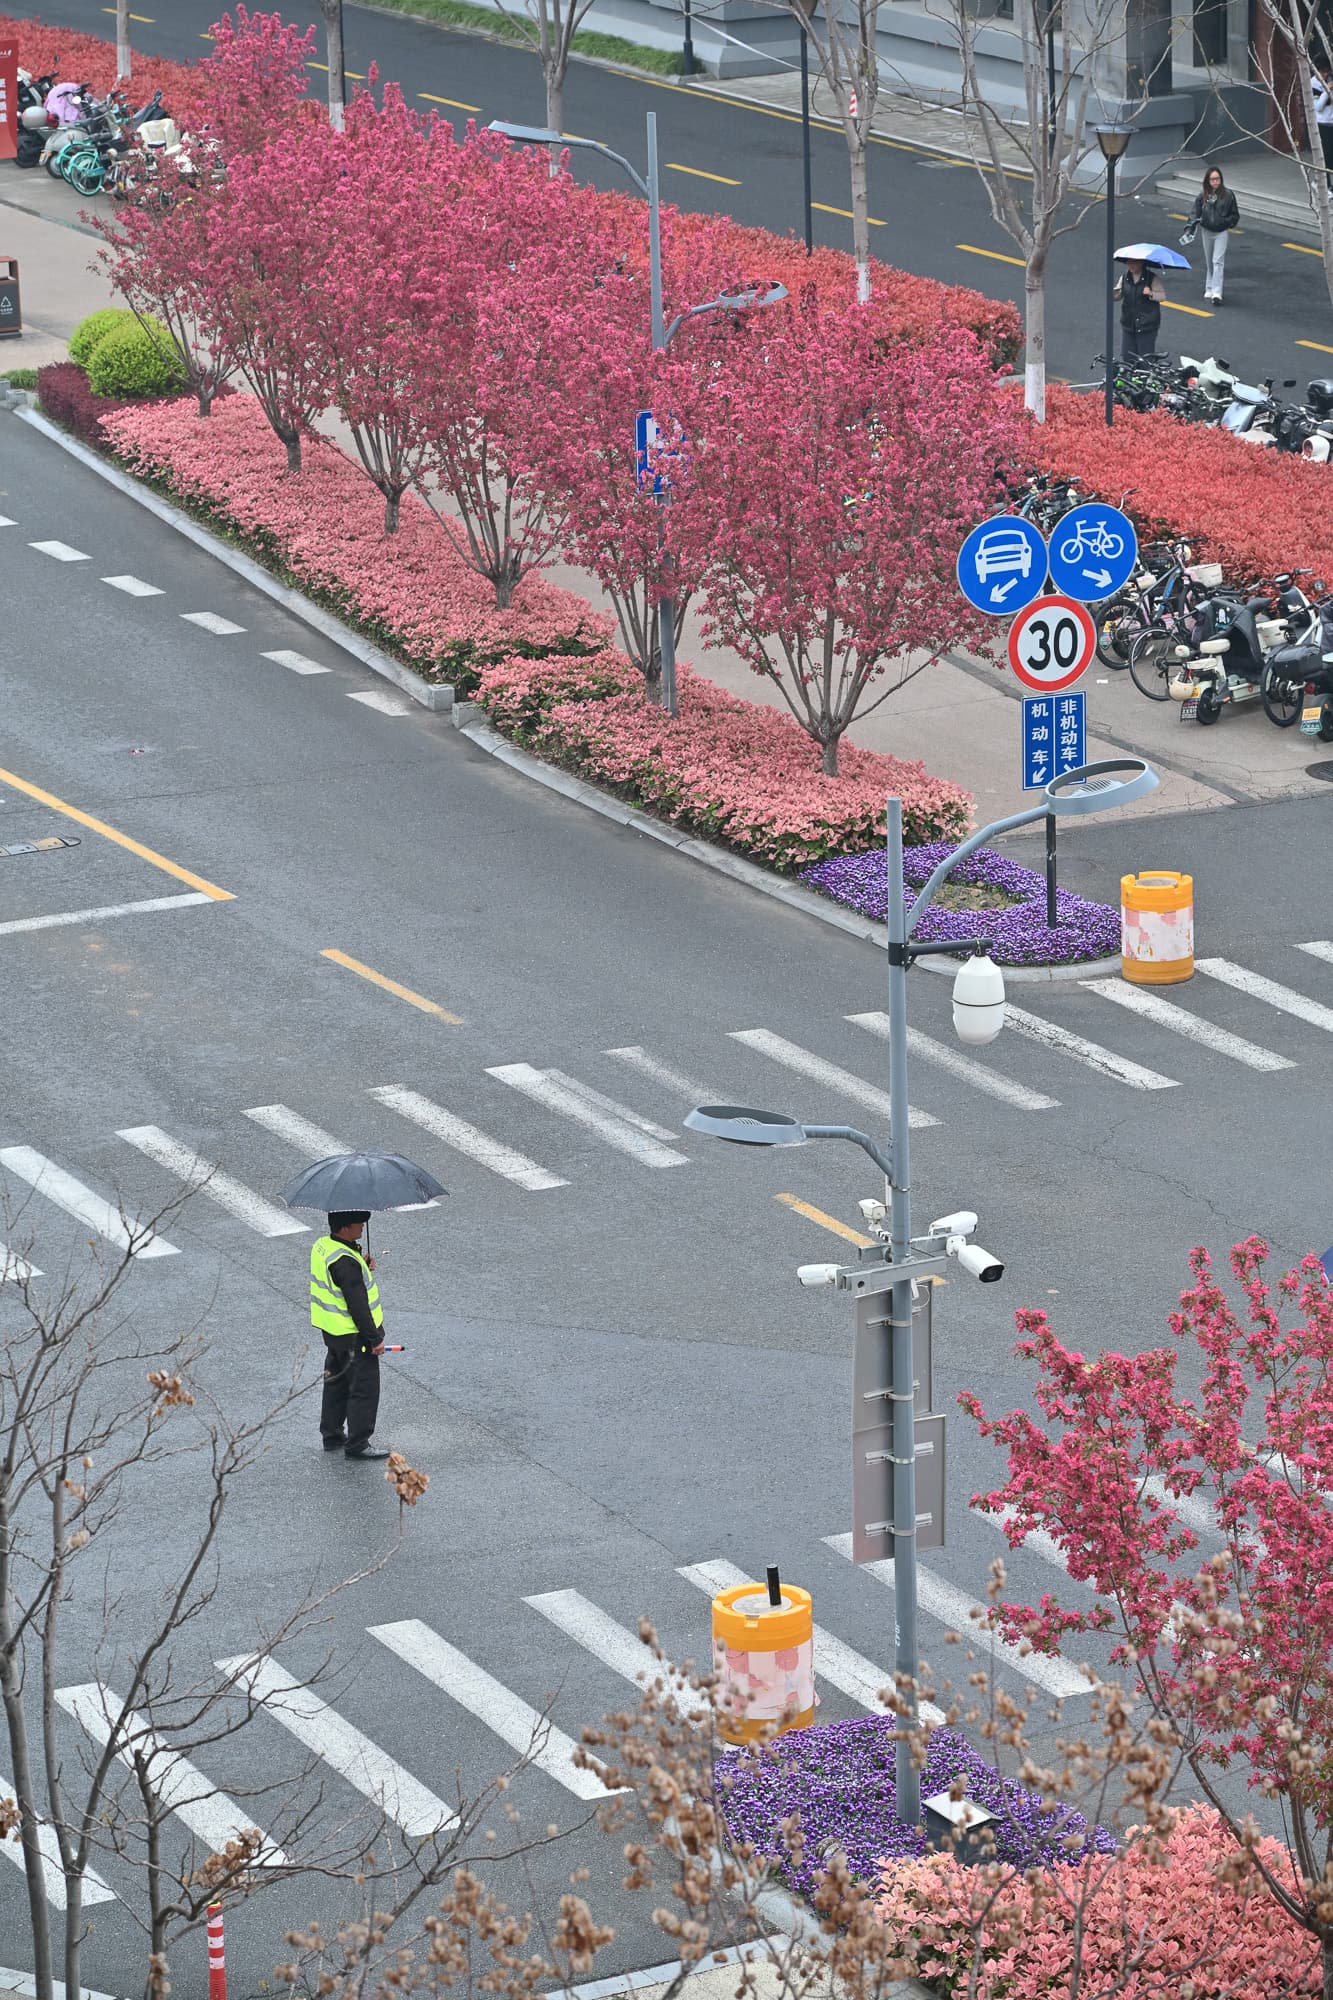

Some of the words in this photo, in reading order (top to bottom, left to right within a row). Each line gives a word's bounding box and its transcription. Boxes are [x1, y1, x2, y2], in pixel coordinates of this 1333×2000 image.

[1027, 617, 1078, 671] 30
[1031, 702, 1048, 764] 机动车
[1060, 699, 1078, 761] 非机动车
